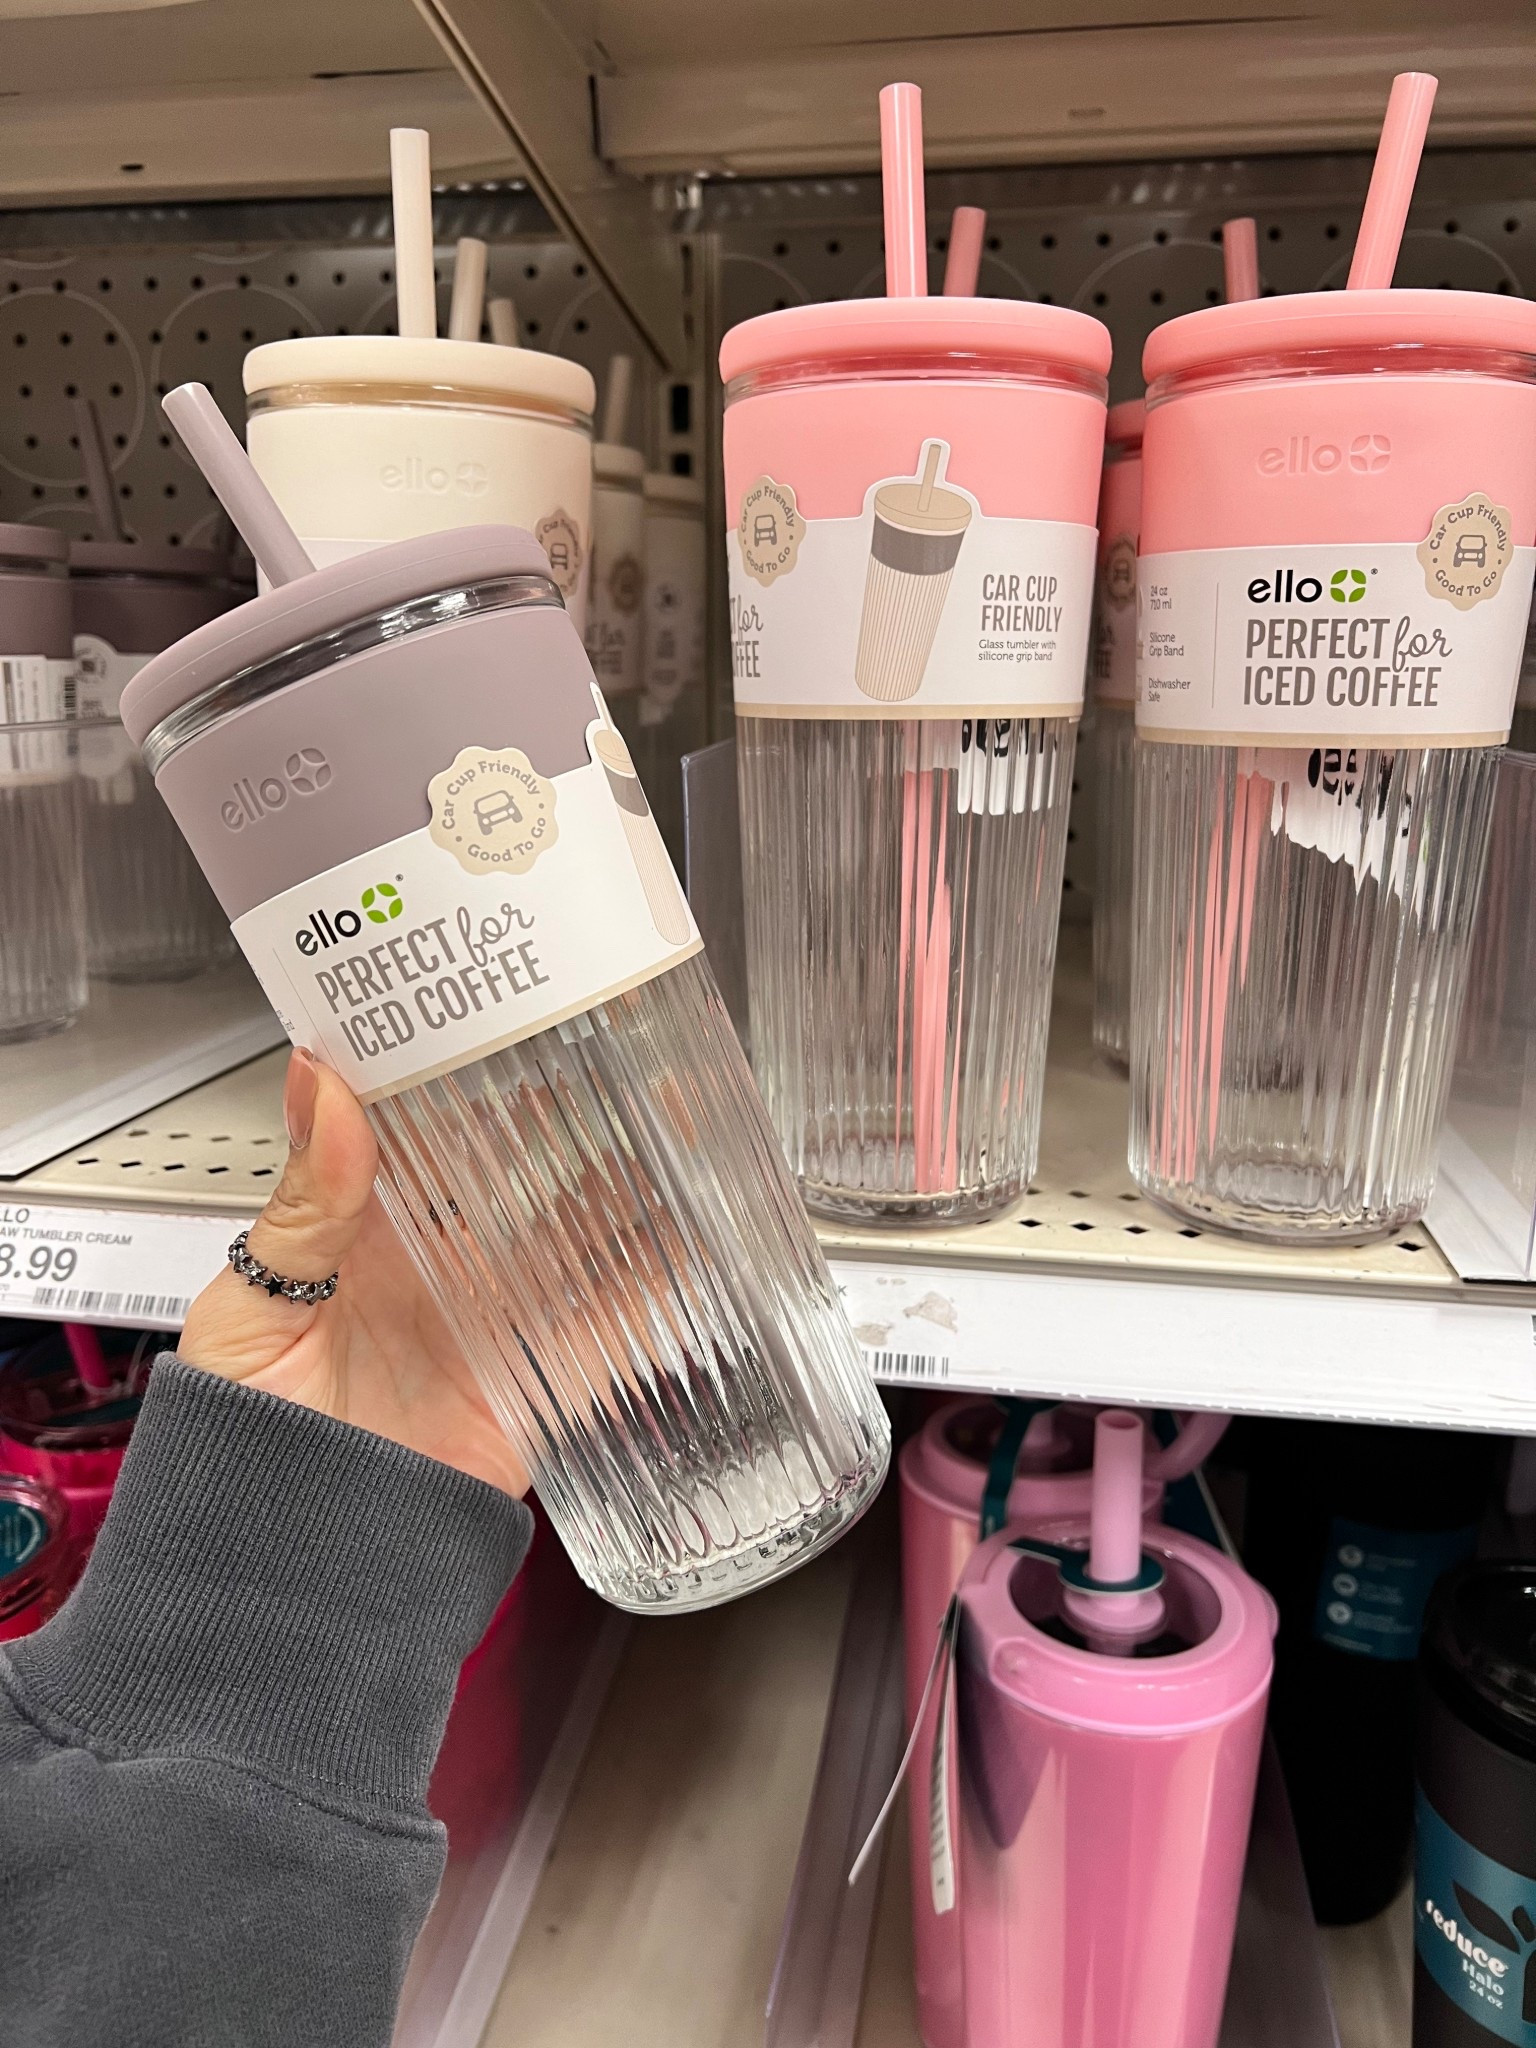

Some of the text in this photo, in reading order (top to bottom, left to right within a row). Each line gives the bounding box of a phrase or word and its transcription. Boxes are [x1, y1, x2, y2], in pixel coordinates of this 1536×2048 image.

[1258, 435, 1342, 476] ello
[380, 456, 449, 492] ello
[746, 490, 762, 508] Cup
[764, 486, 794, 528] Friendly
[1429, 504, 1507, 552] Car Cup Friendly
[746, 546, 791, 574] Good To Go
[982, 573, 1058, 602] CAR CUP
[1150, 585, 1168, 597] 24 oz
[1247, 569, 1323, 604] ello
[1435, 569, 1497, 597] Good To Go
[981, 604, 1063, 632] FRIENDLY
[1162, 598, 1172, 610] ml
[978, 639, 1057, 650] Glass tumbler with
[1149, 632, 1176, 643] Silicone
[1149, 644, 1184, 659] Grip Band
[1246, 615, 1453, 673] PERFECT for
[978, 651, 1053, 663] silicone grip band
[1148, 677, 1191, 690] Dishwasher
[1148, 690, 1161, 702] Safe
[1243, 665, 1442, 707] ICED COFFEE
[220, 777, 288, 832] ello
[442, 760, 541, 830] Car Cup Friendly
[467, 817, 546, 862] Good To Go
[295, 909, 362, 957] ello
[315, 902, 535, 1015] PERFECT for
[339, 939, 551, 1062] ICED COFFEE
[22, 1228, 83, 1243] TUMBLER
[86, 1232, 133, 1246] CREAM
[1425, 1899, 1506, 1978] reduce
[1462, 1958, 1504, 1996] Halo
[1469, 1979, 1503, 2010] 24 oz
